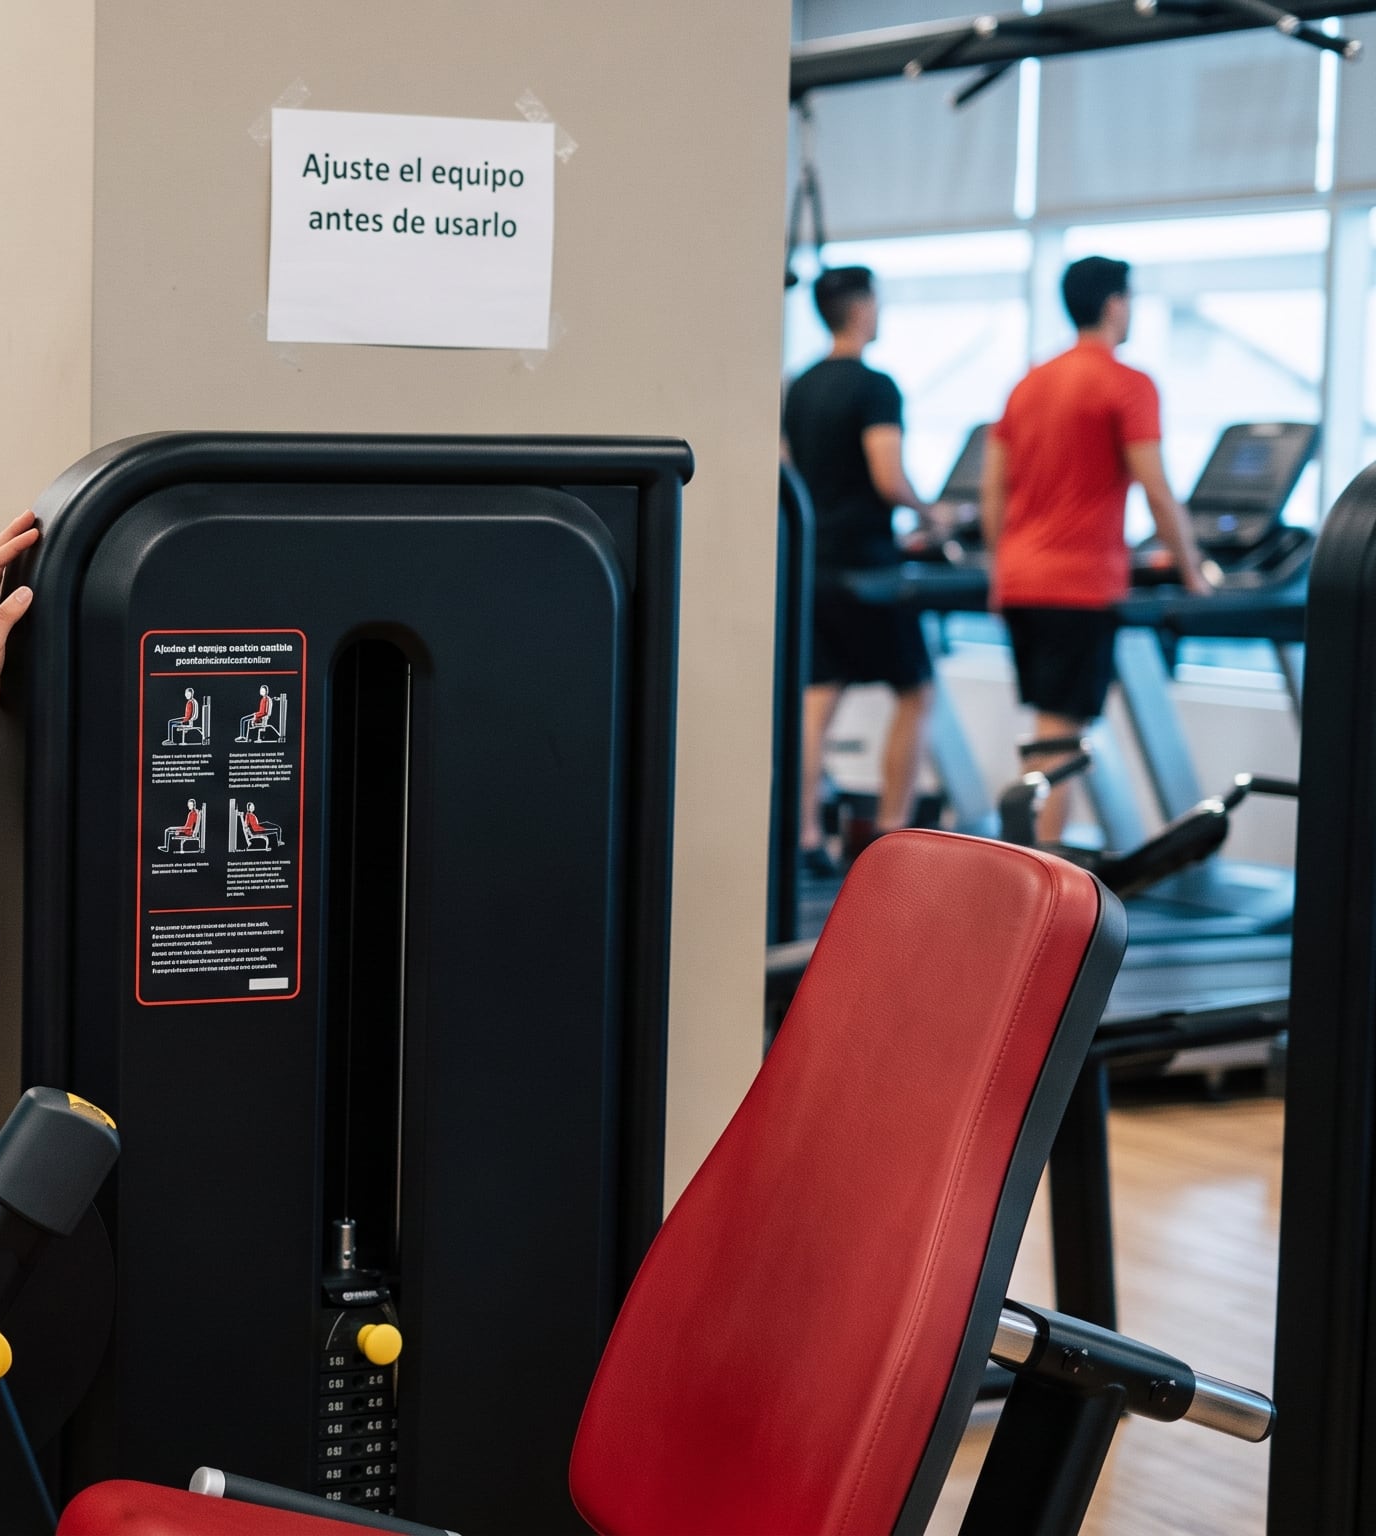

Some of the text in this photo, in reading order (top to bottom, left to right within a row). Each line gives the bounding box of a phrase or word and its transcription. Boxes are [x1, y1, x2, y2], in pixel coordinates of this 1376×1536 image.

[303, 153, 523, 192] Ajuste el equipo
[309, 208, 516, 237] antes de usarlo
